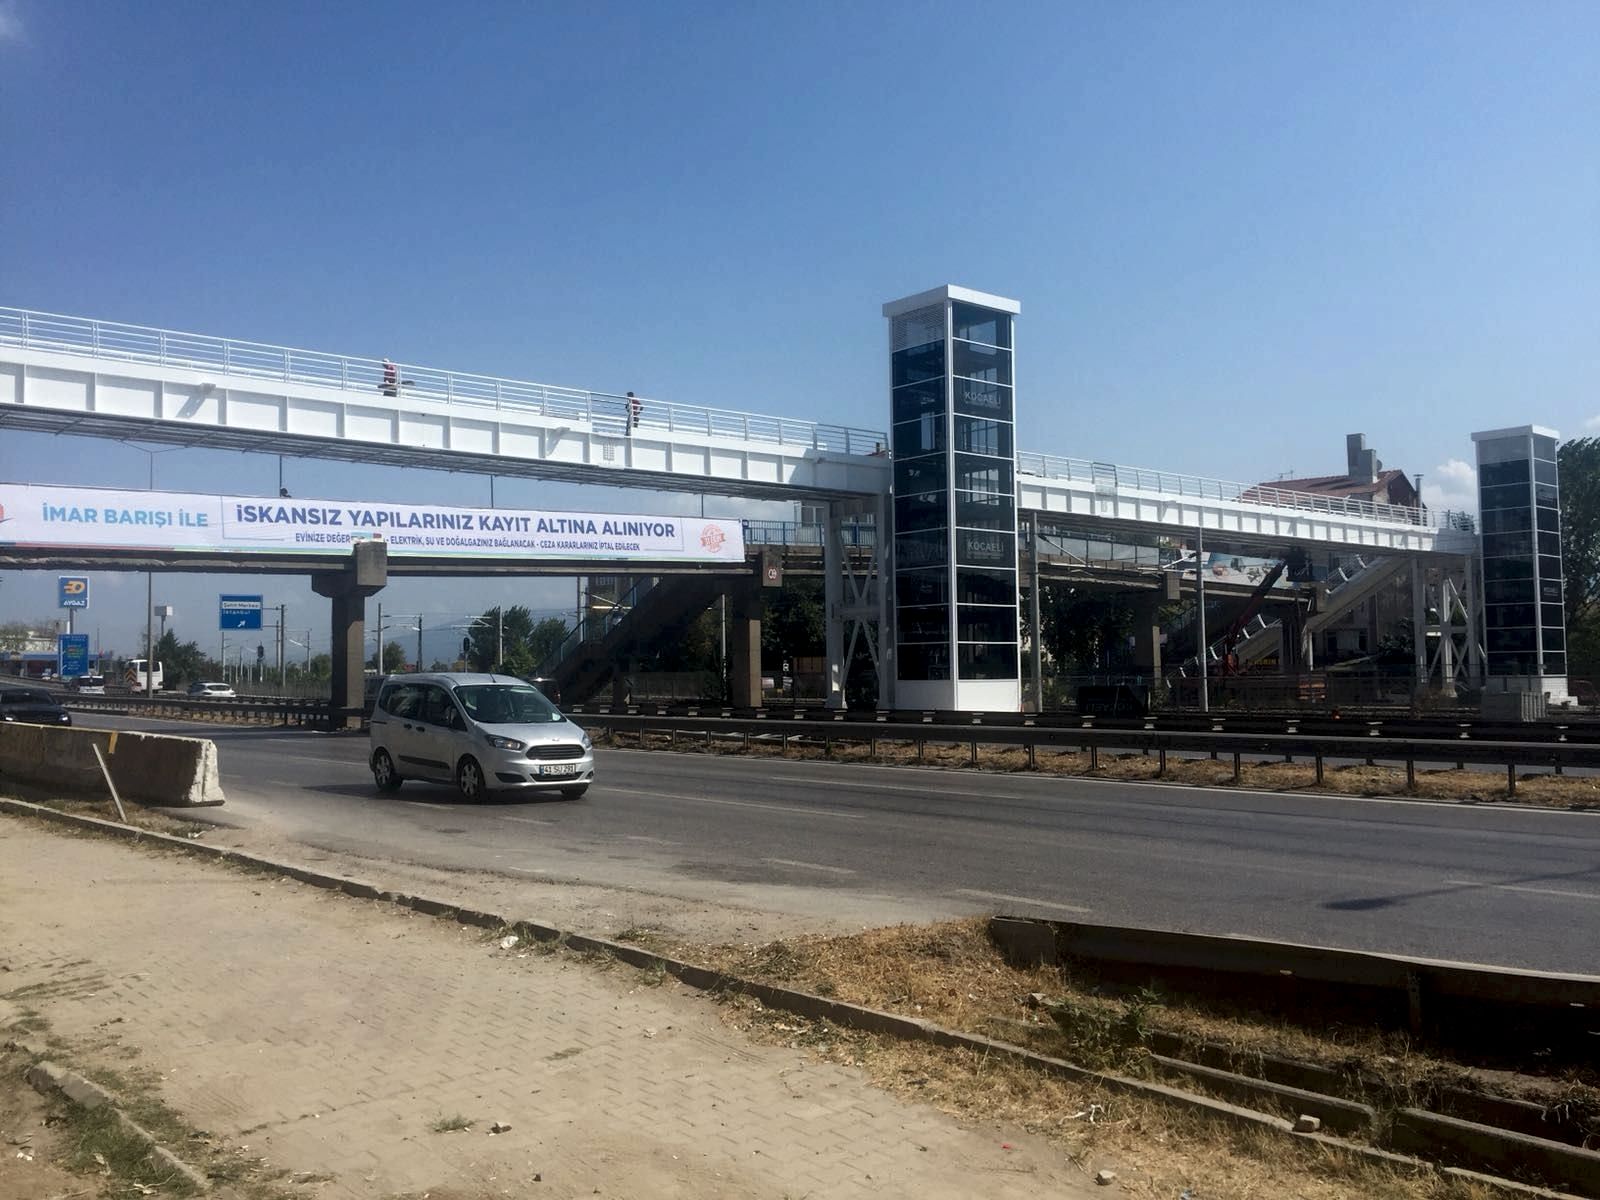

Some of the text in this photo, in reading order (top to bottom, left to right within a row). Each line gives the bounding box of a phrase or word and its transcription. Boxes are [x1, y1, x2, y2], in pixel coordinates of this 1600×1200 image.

[42, 502, 209, 528] İMAR BARIŞI İLE
[236, 504, 675, 538] İSKANSIZ YAPILARINIZ KAYIT ALTINA ALINIYOR
[295, 531, 326, 542] EVİNİZE
[425, 537, 435, 546] SU
[436, 537, 445, 546] VE
[445, 535, 493, 547] DOĞALGAZINIZ
[494, 537, 535, 548] BAĞLANACAK
[539, 540, 556, 549] CEZA
[556, 541, 598, 550] KARARLARINIZ
[598, 540, 614, 551] İPTAL
[615, 542, 640, 551] EDİLECEK
